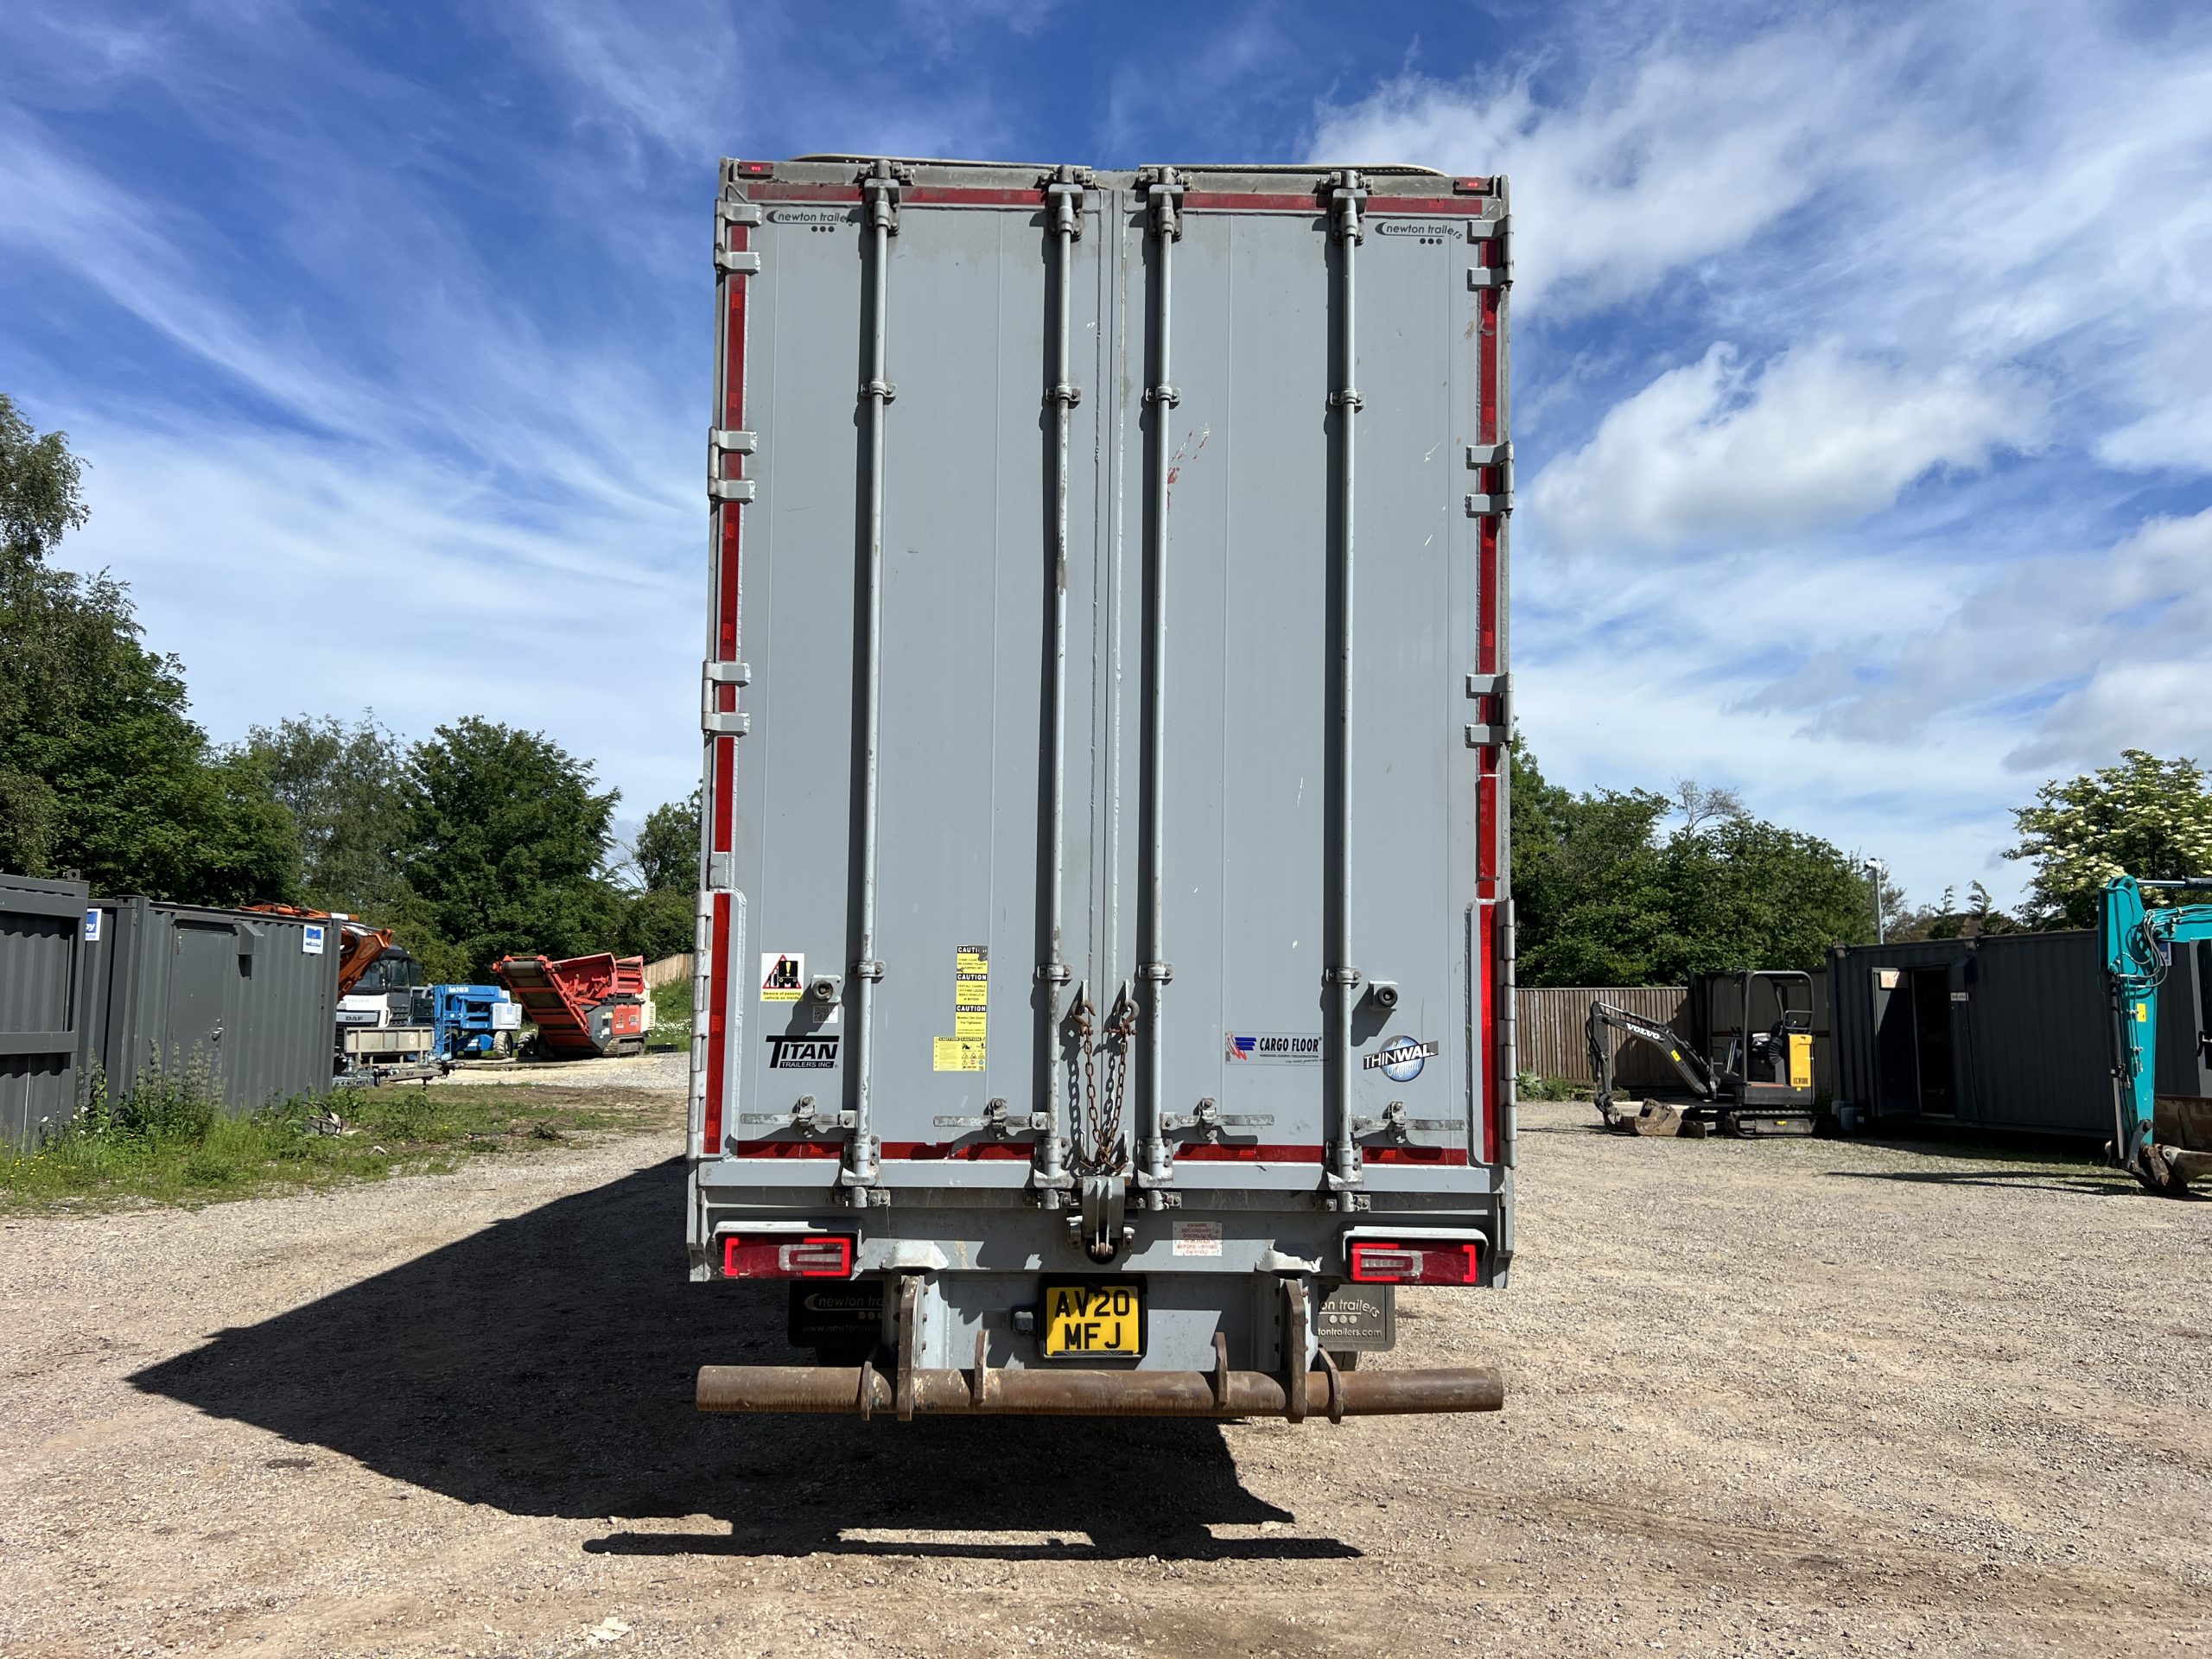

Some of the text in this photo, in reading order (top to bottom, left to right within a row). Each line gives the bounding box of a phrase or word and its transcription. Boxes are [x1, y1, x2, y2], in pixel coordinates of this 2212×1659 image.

[778, 212, 817, 222] newton
[1386, 225, 1463, 240] newton trailers
[1625, 1022, 1661, 1039] VOLVO
[766, 1035, 840, 1069] TITAN
[1259, 1037, 1319, 1052] CARGO FLOOR
[818, 1295, 864, 1307] newton
[1054, 1289, 1130, 1318] AV20
[1338, 1299, 1380, 1318] trailers
[1064, 1321, 1121, 1351] MFJ
